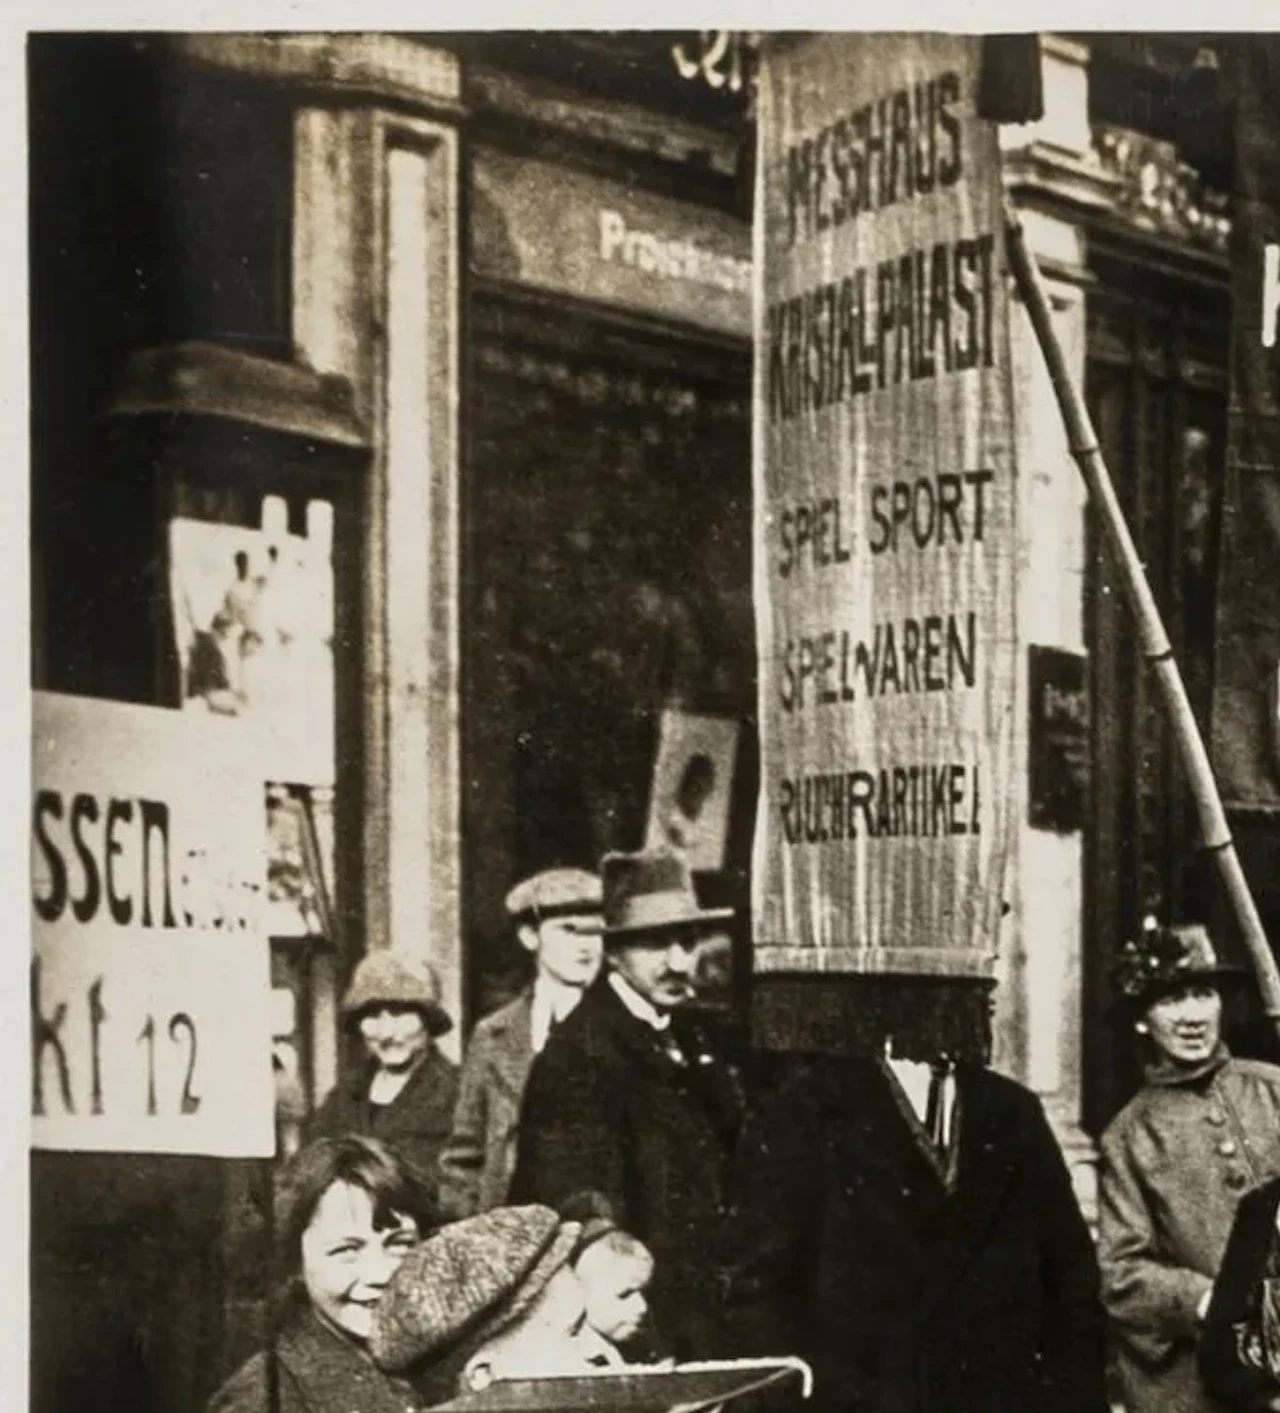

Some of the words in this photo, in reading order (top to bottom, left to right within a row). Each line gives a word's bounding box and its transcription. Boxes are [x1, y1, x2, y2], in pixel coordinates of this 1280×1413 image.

[869, 469, 993, 556] SPORT
[777, 610, 976, 715] SPELWAREN
[135, 1011, 202, 1116] 12
